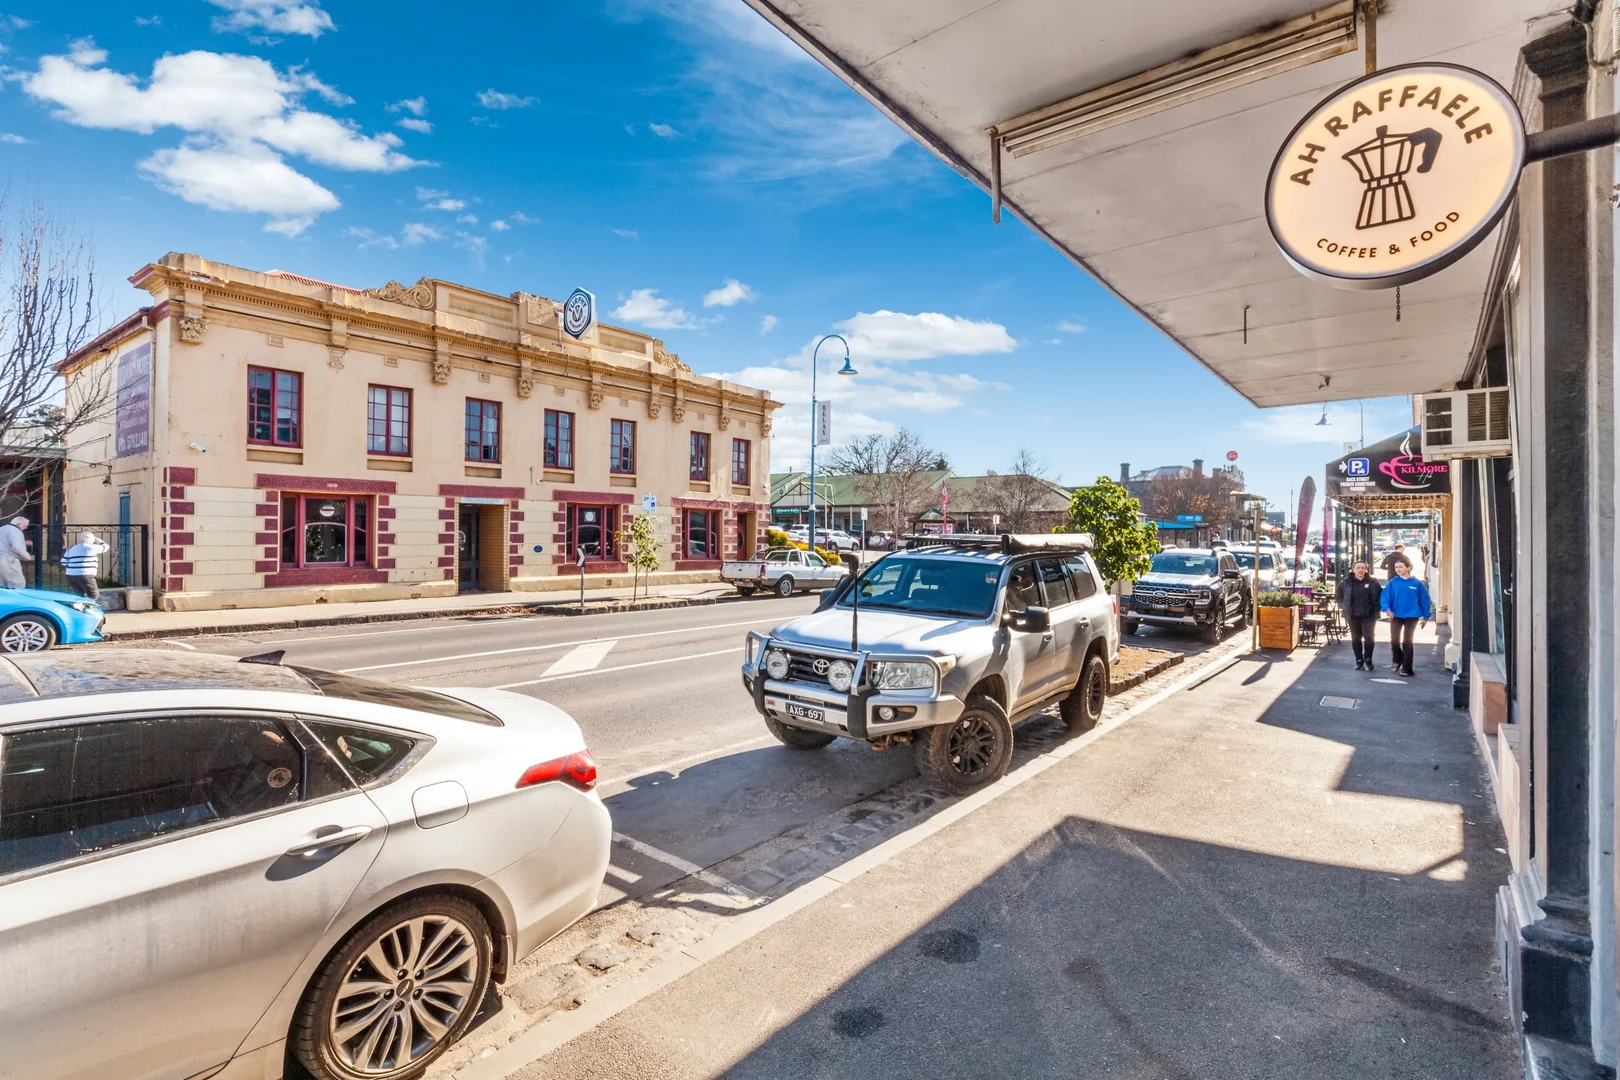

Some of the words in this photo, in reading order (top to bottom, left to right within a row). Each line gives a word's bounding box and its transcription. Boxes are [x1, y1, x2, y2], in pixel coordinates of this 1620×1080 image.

[1289, 142, 1326, 186] AH
[1323, 84, 1493, 144] RAFFAELE
[1316, 237, 1377, 258] COFFEE
[1388, 243, 1400, 254] &
[1409, 211, 1460, 248] FOOD
[1351, 461, 1363, 473] P
[1401, 465, 1448, 474] KILMORE
